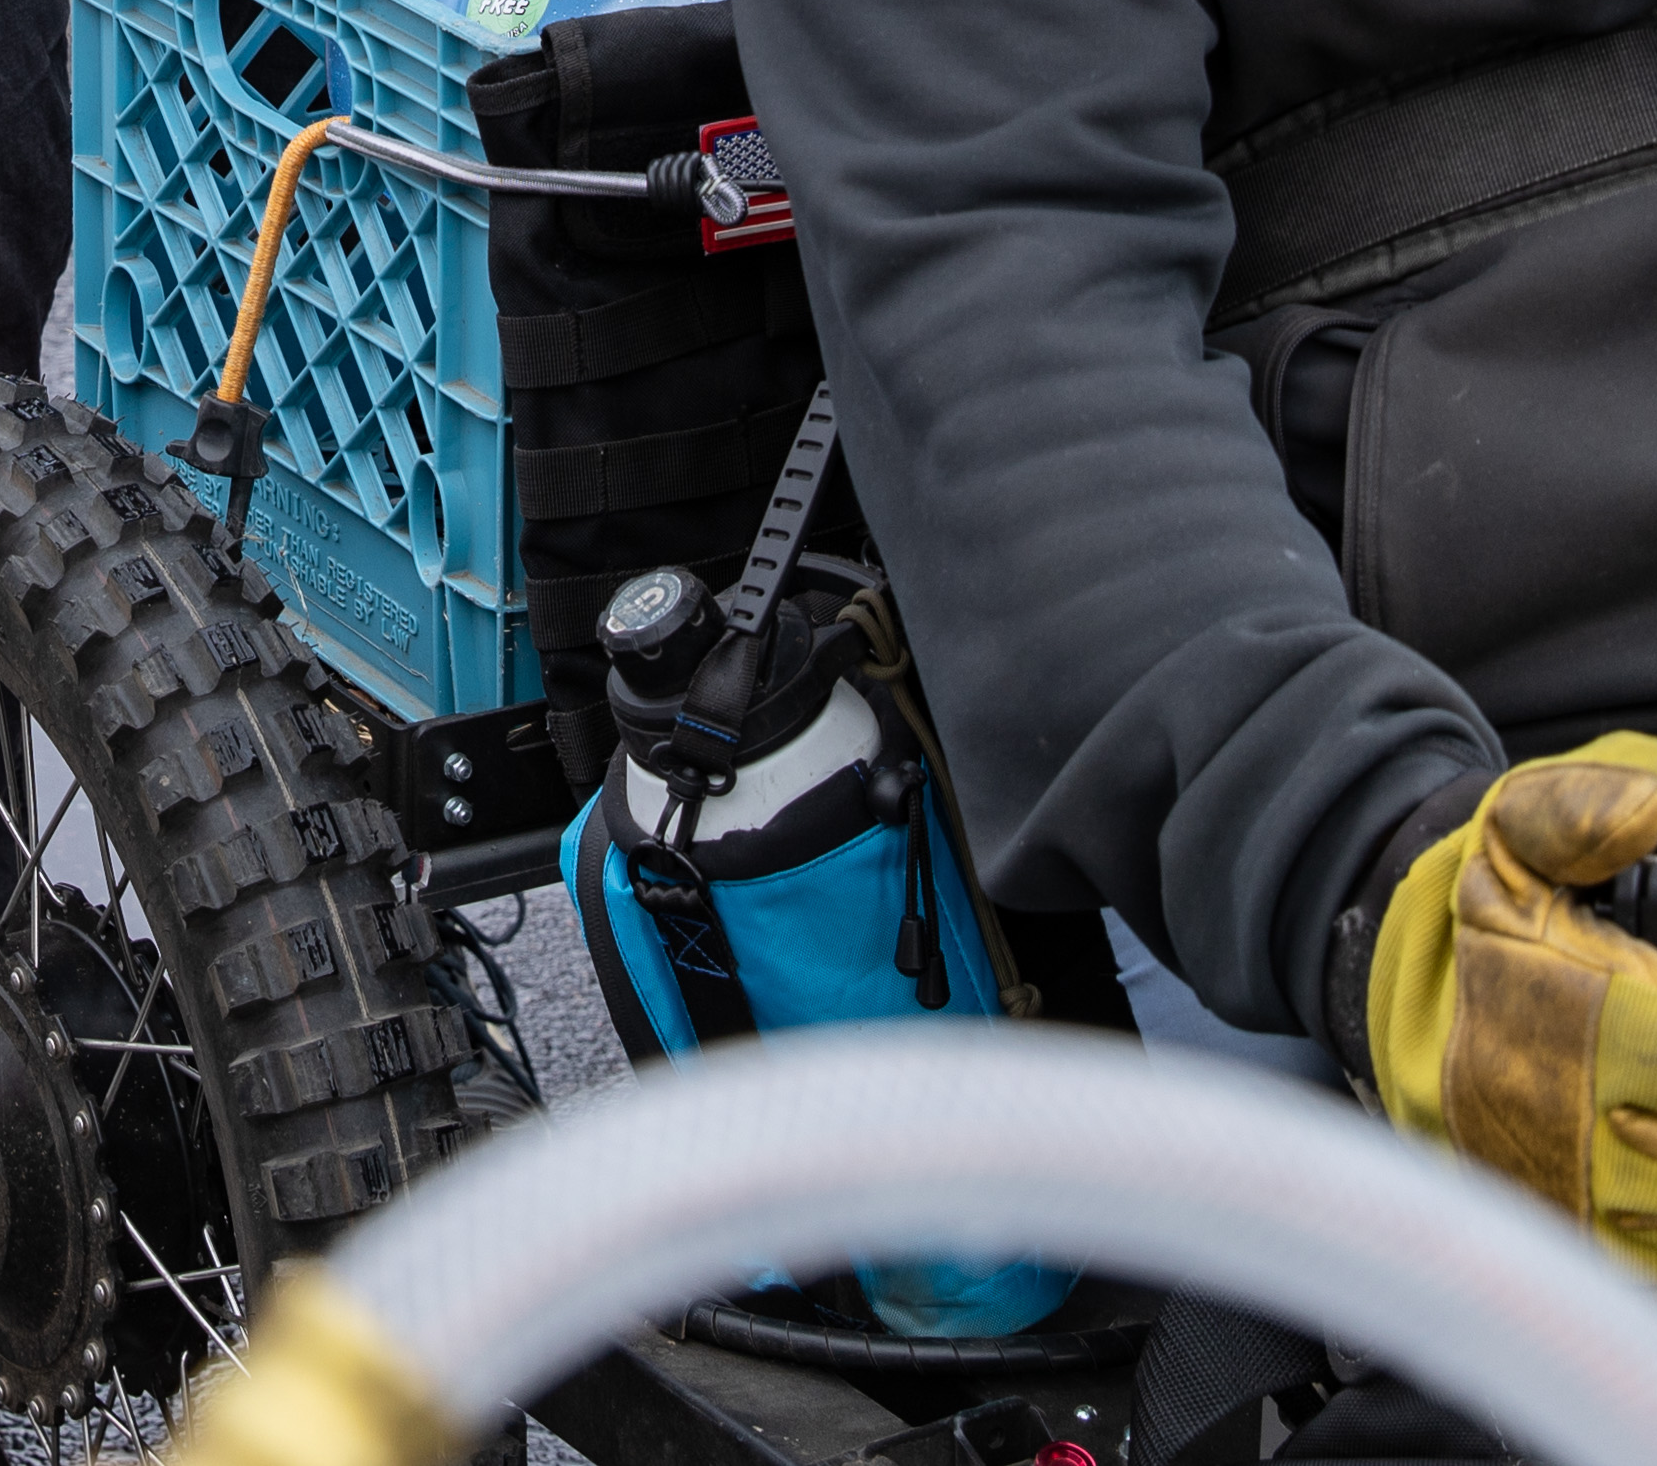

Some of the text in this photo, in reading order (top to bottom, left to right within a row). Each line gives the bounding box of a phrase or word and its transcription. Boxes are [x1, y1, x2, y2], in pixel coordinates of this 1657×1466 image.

[252, 474, 340, 543] ARNING:
[204, 473, 223, 499] BY
[247, 506, 275, 540] HER
[281, 526, 321, 568] THAN
[326, 556, 419, 636] REGISTERED
[353, 599, 375, 626] BY
[381, 617, 413, 653] LAW
